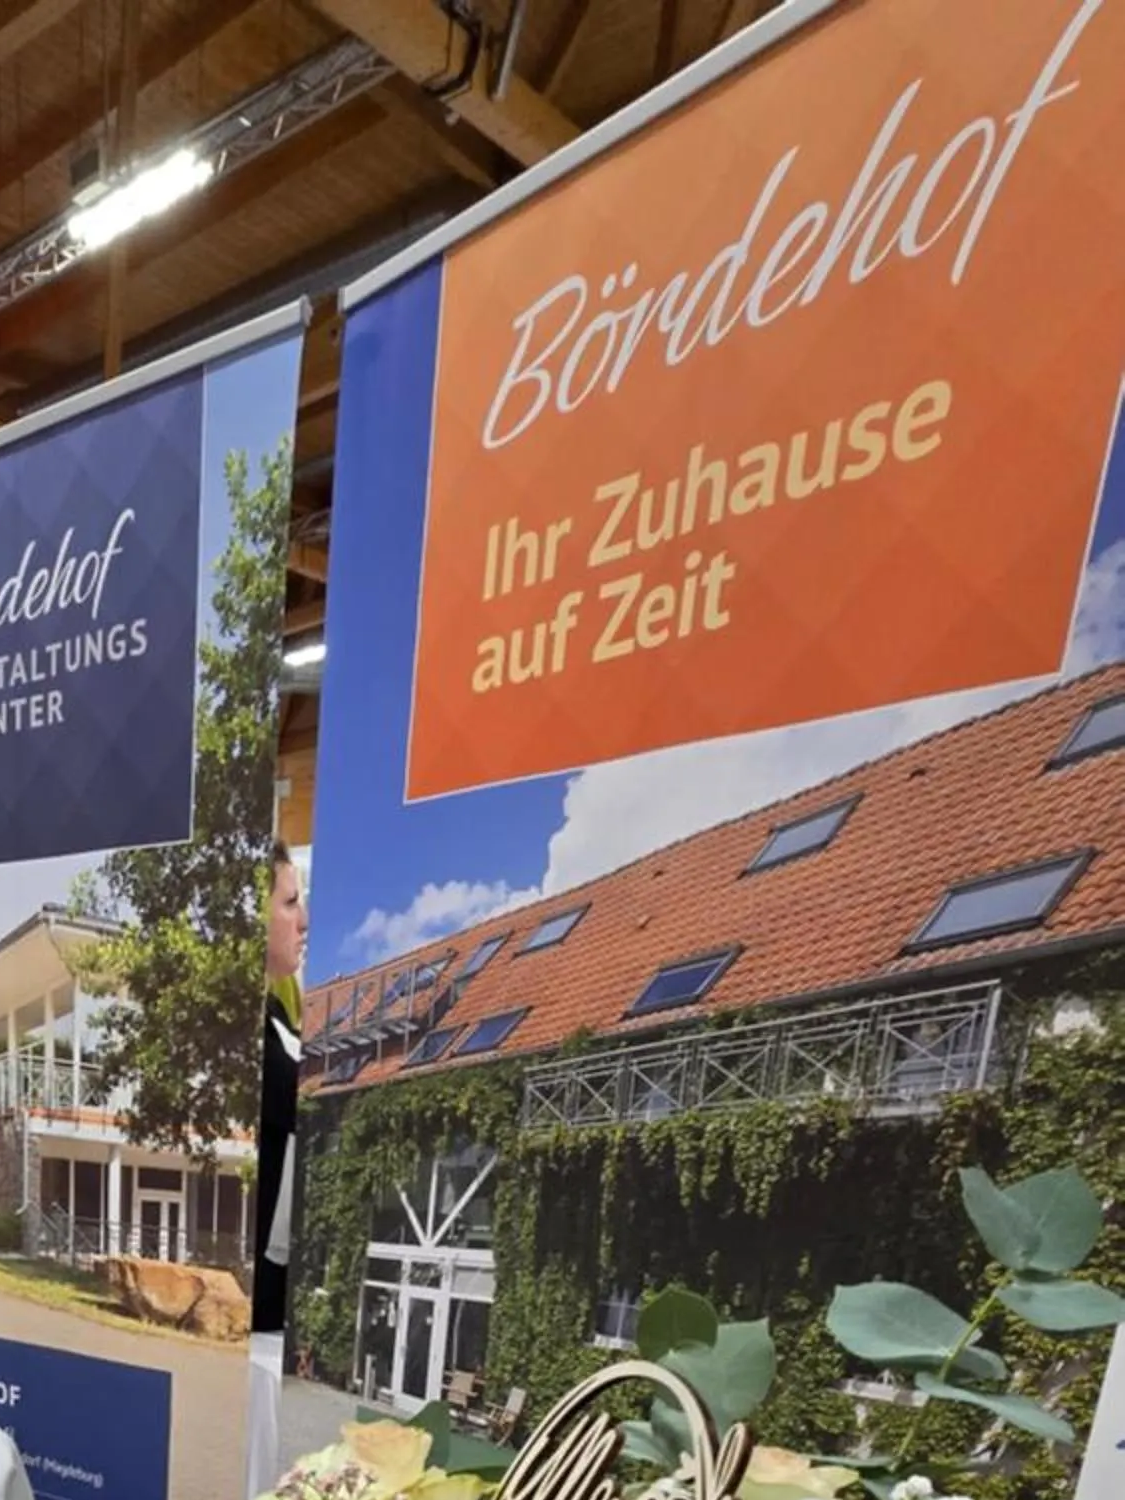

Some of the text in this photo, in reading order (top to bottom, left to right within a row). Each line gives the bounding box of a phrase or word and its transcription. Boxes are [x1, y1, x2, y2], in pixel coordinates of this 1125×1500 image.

[482, 0, 1103, 450] Bördehof
[482, 379, 952, 601] Ihr Zuhause
[472, 550, 736, 692] auf Zeit
